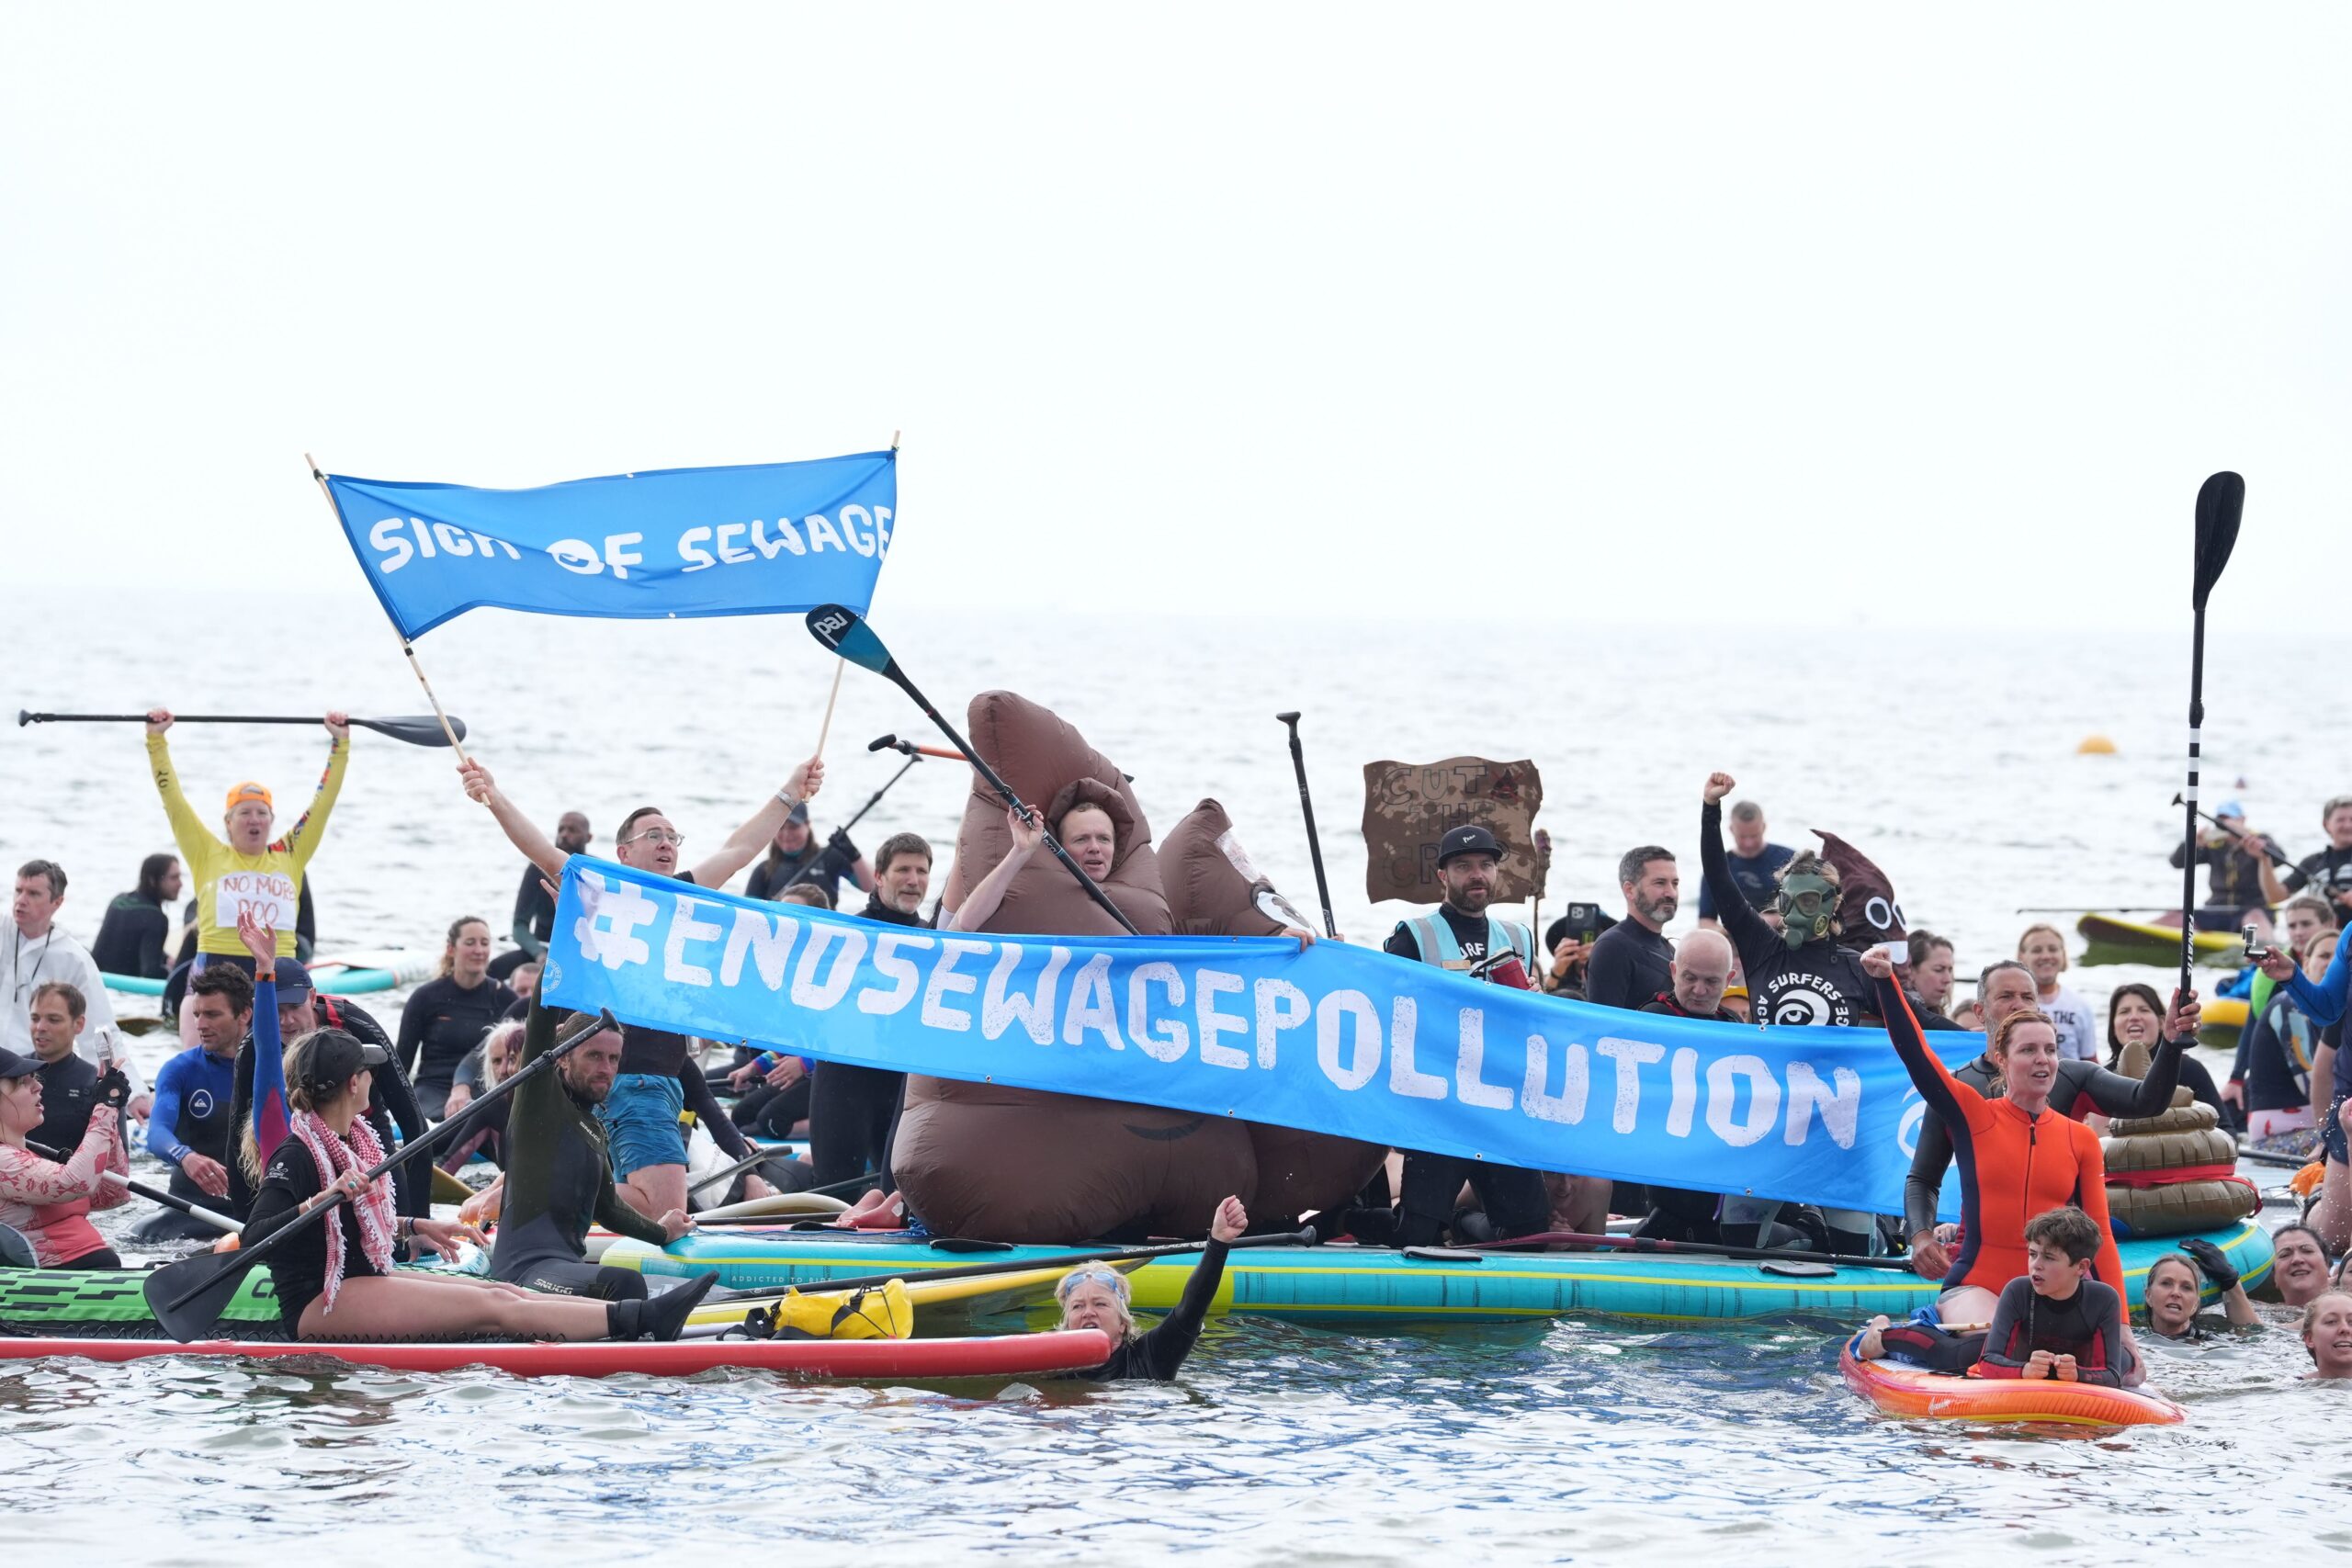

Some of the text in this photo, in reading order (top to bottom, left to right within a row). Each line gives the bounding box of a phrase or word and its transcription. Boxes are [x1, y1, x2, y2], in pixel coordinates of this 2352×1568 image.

[546, 533, 643, 580] OF
[678, 504, 892, 572] SEWAGE
[1381, 765, 1487, 805] CUT
[224, 875, 250, 893] NO
[1768, 972, 1842, 1001] SURFERS
[575, 868, 1860, 1147] #ENDSEWAGEPOLLUTION
[2053, 1010, 2075, 1025] THE
[534, 1278, 574, 1295] SNUGG
[731, 1275, 785, 1283] ADDICTED
